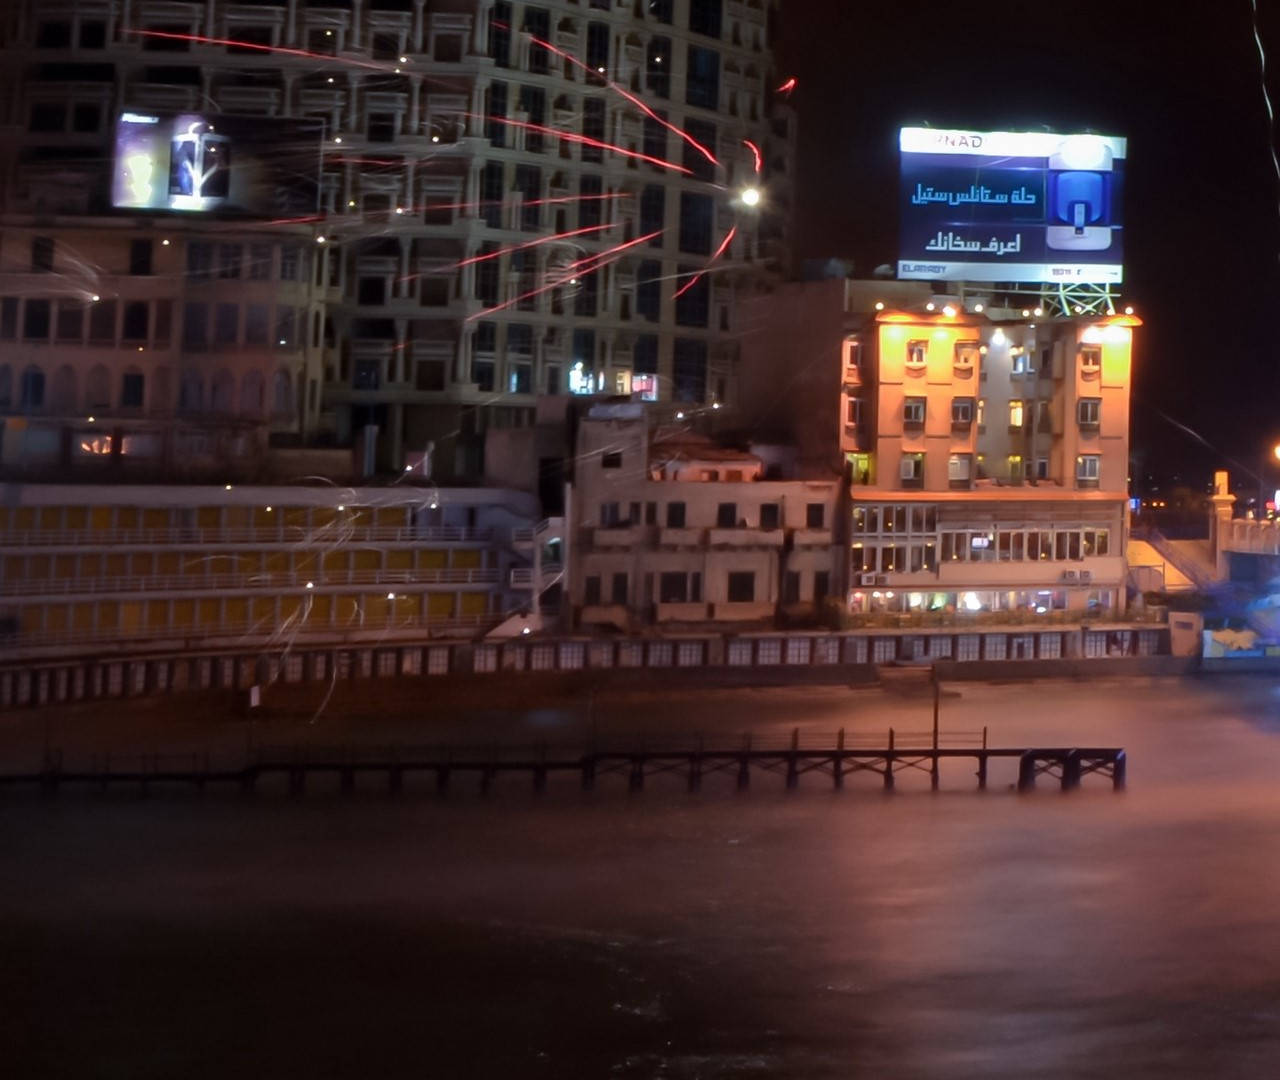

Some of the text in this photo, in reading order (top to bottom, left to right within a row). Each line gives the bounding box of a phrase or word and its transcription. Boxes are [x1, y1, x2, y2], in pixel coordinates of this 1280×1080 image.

[911, 183, 1036, 205] حلة ستانلس ستيل
[925, 231, 1021, 255] اعرف سخانك
